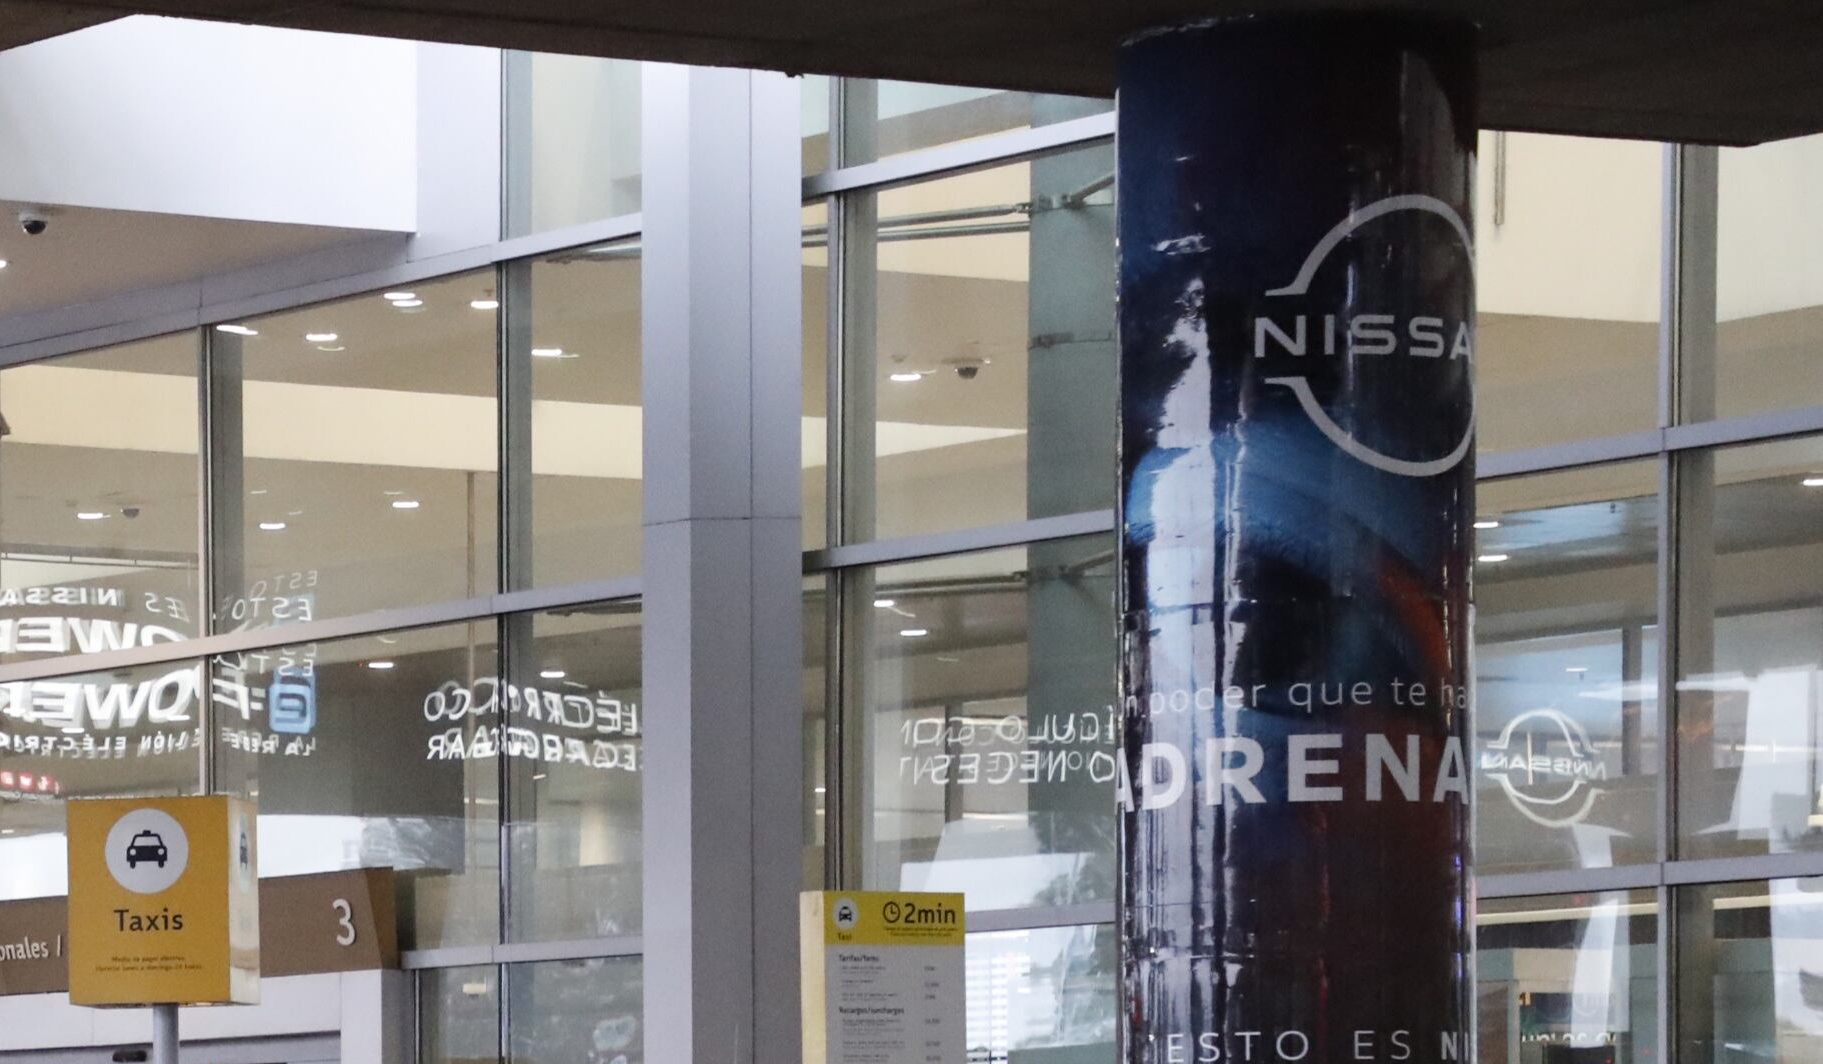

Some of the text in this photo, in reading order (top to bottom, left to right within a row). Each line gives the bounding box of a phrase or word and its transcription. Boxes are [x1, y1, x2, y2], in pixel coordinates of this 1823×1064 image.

[1288, 680, 1374, 713] que
[1391, 676, 1428, 707] te
[1115, 732, 1470, 815] ADRENA
[114, 907, 184, 933] Taxis
[332, 898, 358, 947] 3
[904, 902, 956, 924] 2min
[1167, 1030, 1309, 1064] ESTO
[1353, 1029, 1411, 1061] ES
